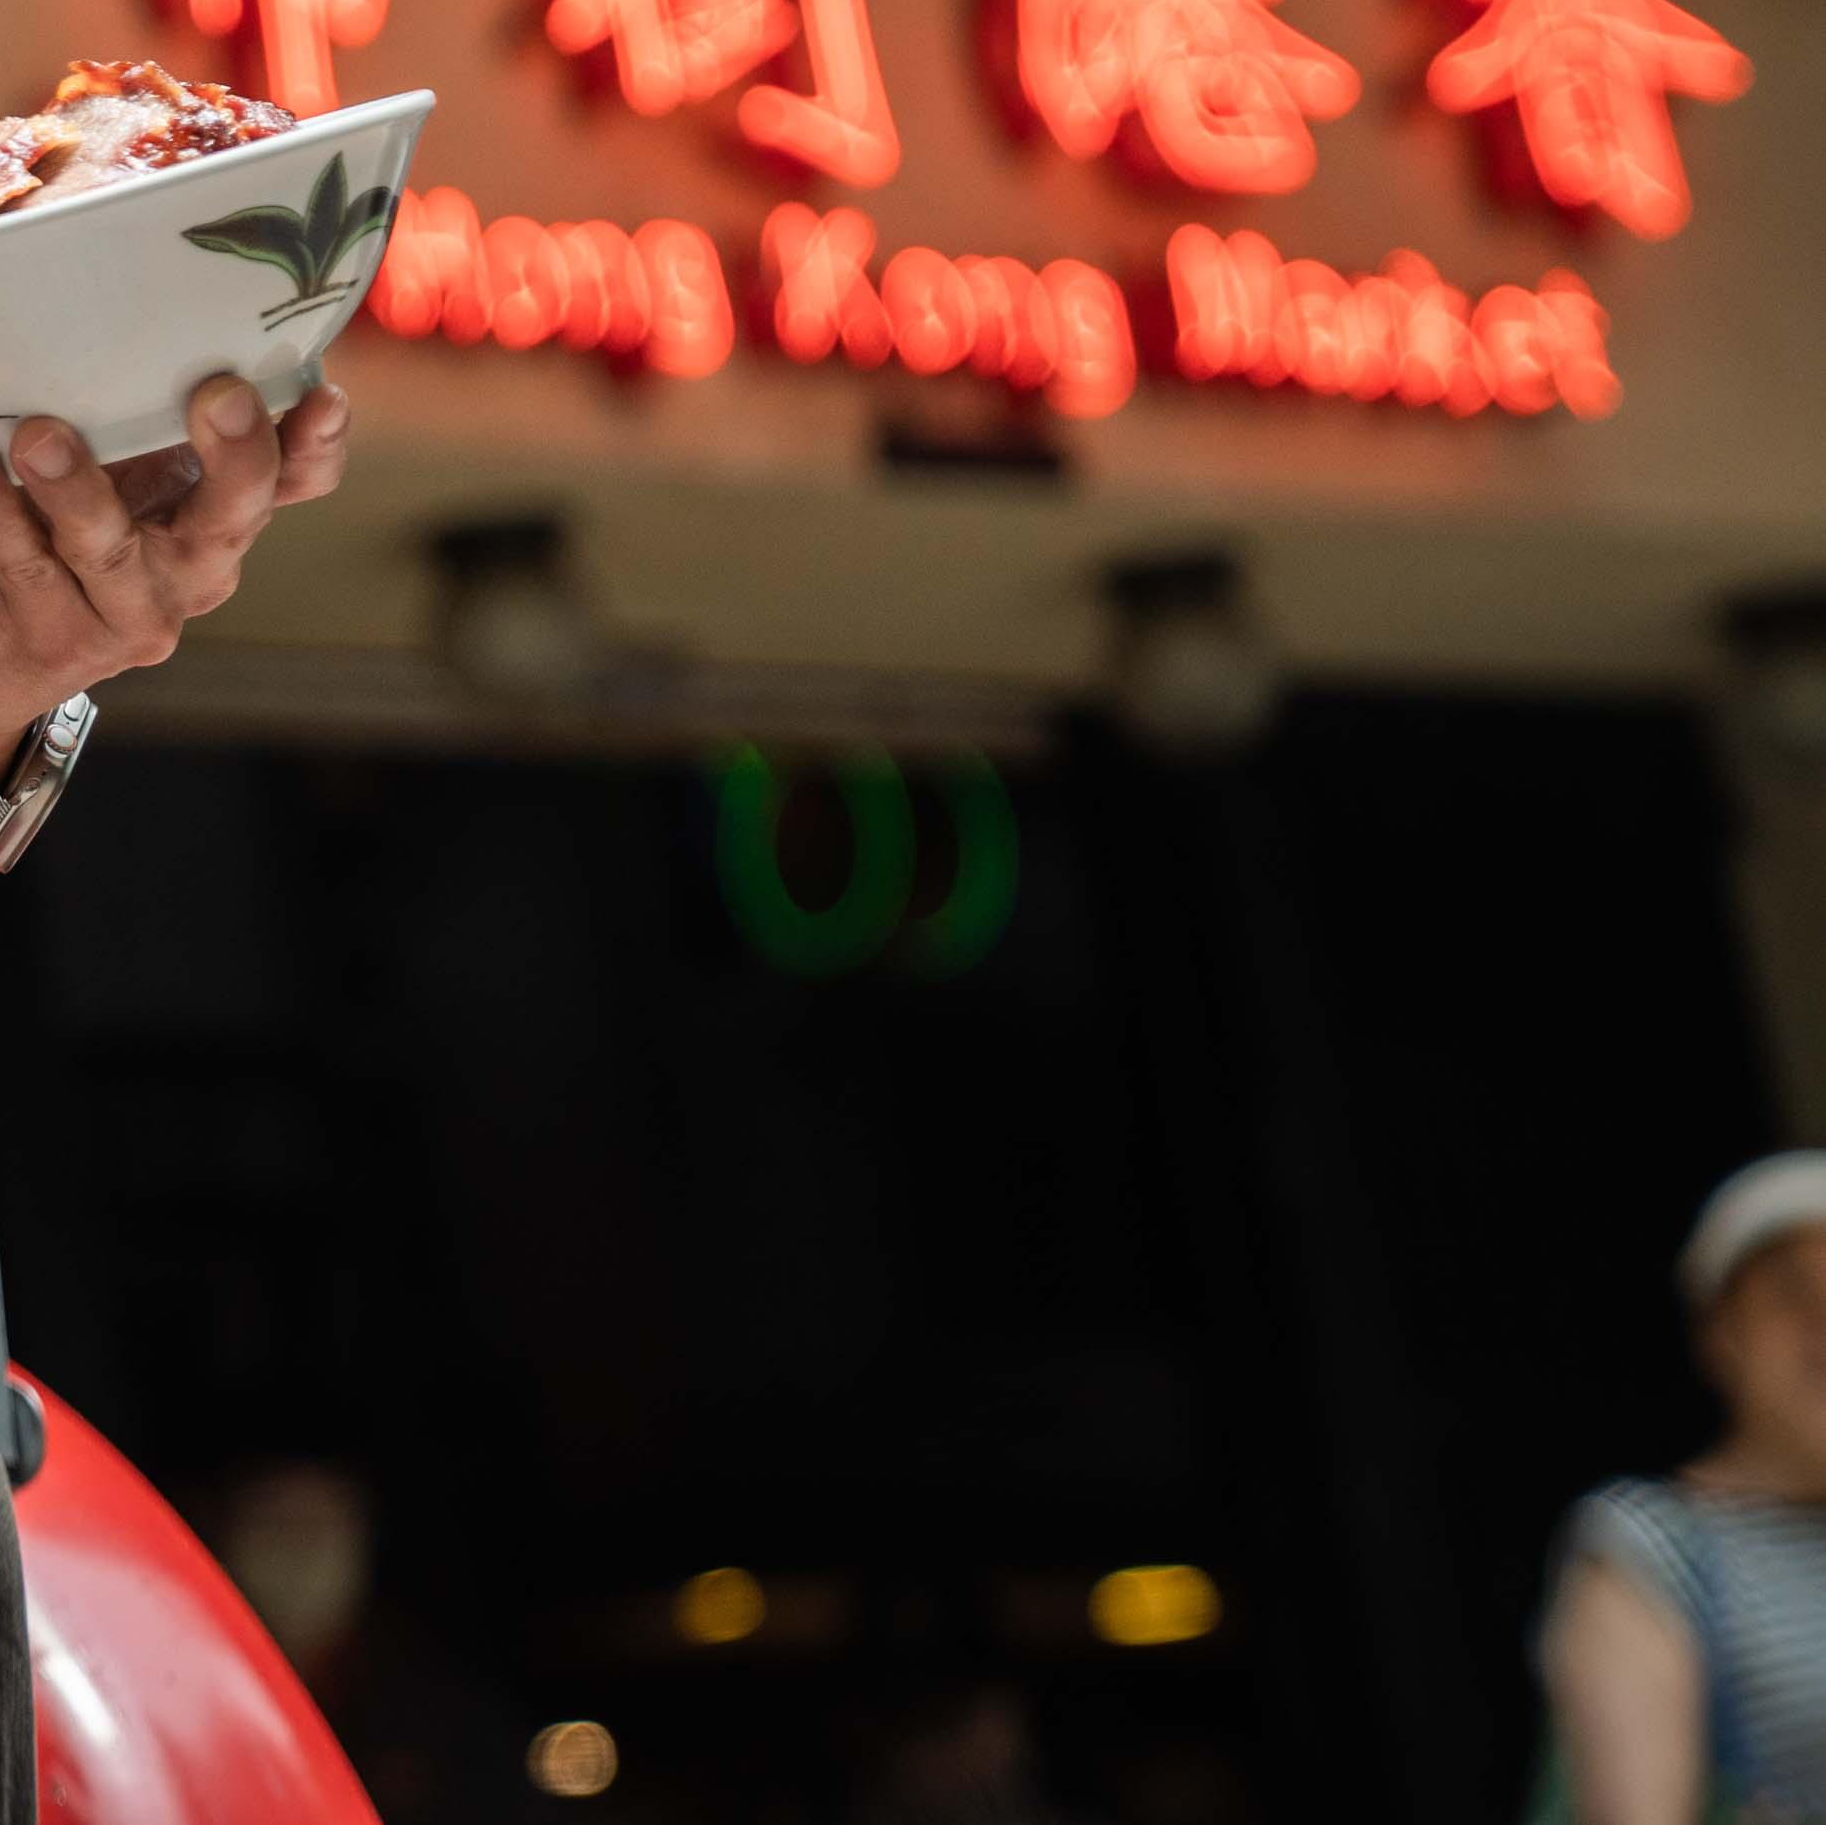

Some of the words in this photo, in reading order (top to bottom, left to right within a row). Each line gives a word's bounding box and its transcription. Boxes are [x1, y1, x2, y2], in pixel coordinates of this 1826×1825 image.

[367, 184, 736, 380] Hong
[760, 200, 1138, 420] Kong
[1165, 222, 1624, 422] Market
